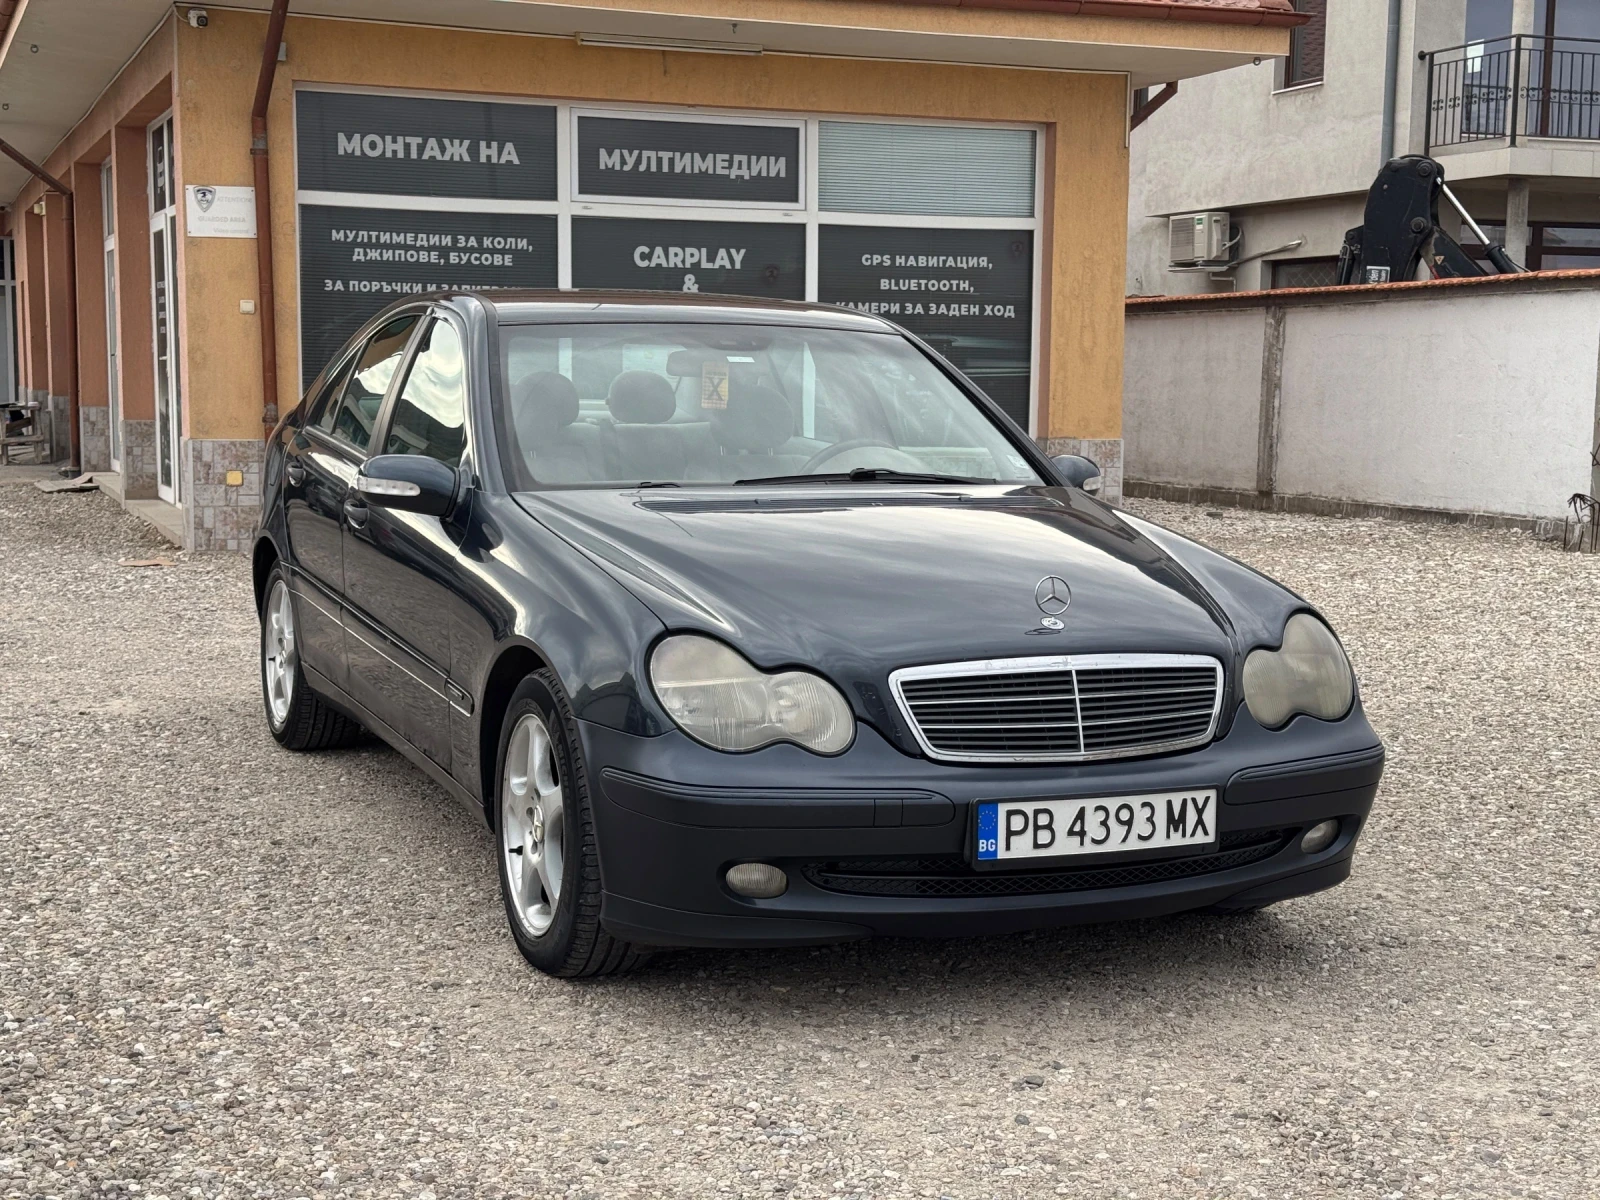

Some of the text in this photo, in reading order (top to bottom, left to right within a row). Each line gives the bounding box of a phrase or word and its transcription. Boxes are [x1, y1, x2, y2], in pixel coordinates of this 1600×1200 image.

[338, 132, 520, 164] МОНТАЖ НА
[599, 148, 786, 179] МУЛТИМЕДИИ
[331, 230, 533, 252] МУЛТИМЕДИИ ЗА КОЛИ,
[353, 248, 513, 266] ДЖИПОВЕ, БУСОВЕ
[633, 246, 746, 269] CARPLAY
[861, 254, 993, 269] GPS НАВИГАЦИЯ,
[324, 280, 345, 291] ЗА
[349, 281, 422, 293] ПОРЪЧКИ
[683, 274, 699, 292] &
[880, 279, 974, 293] BLUETOOTH,
[905, 303, 924, 315] ЗА
[929, 304, 979, 317] ЗАДЕН
[984, 305, 1015, 319] ХОД
[1005, 795, 1211, 851] PB 4393 MX
[978, 839, 996, 852] BG
